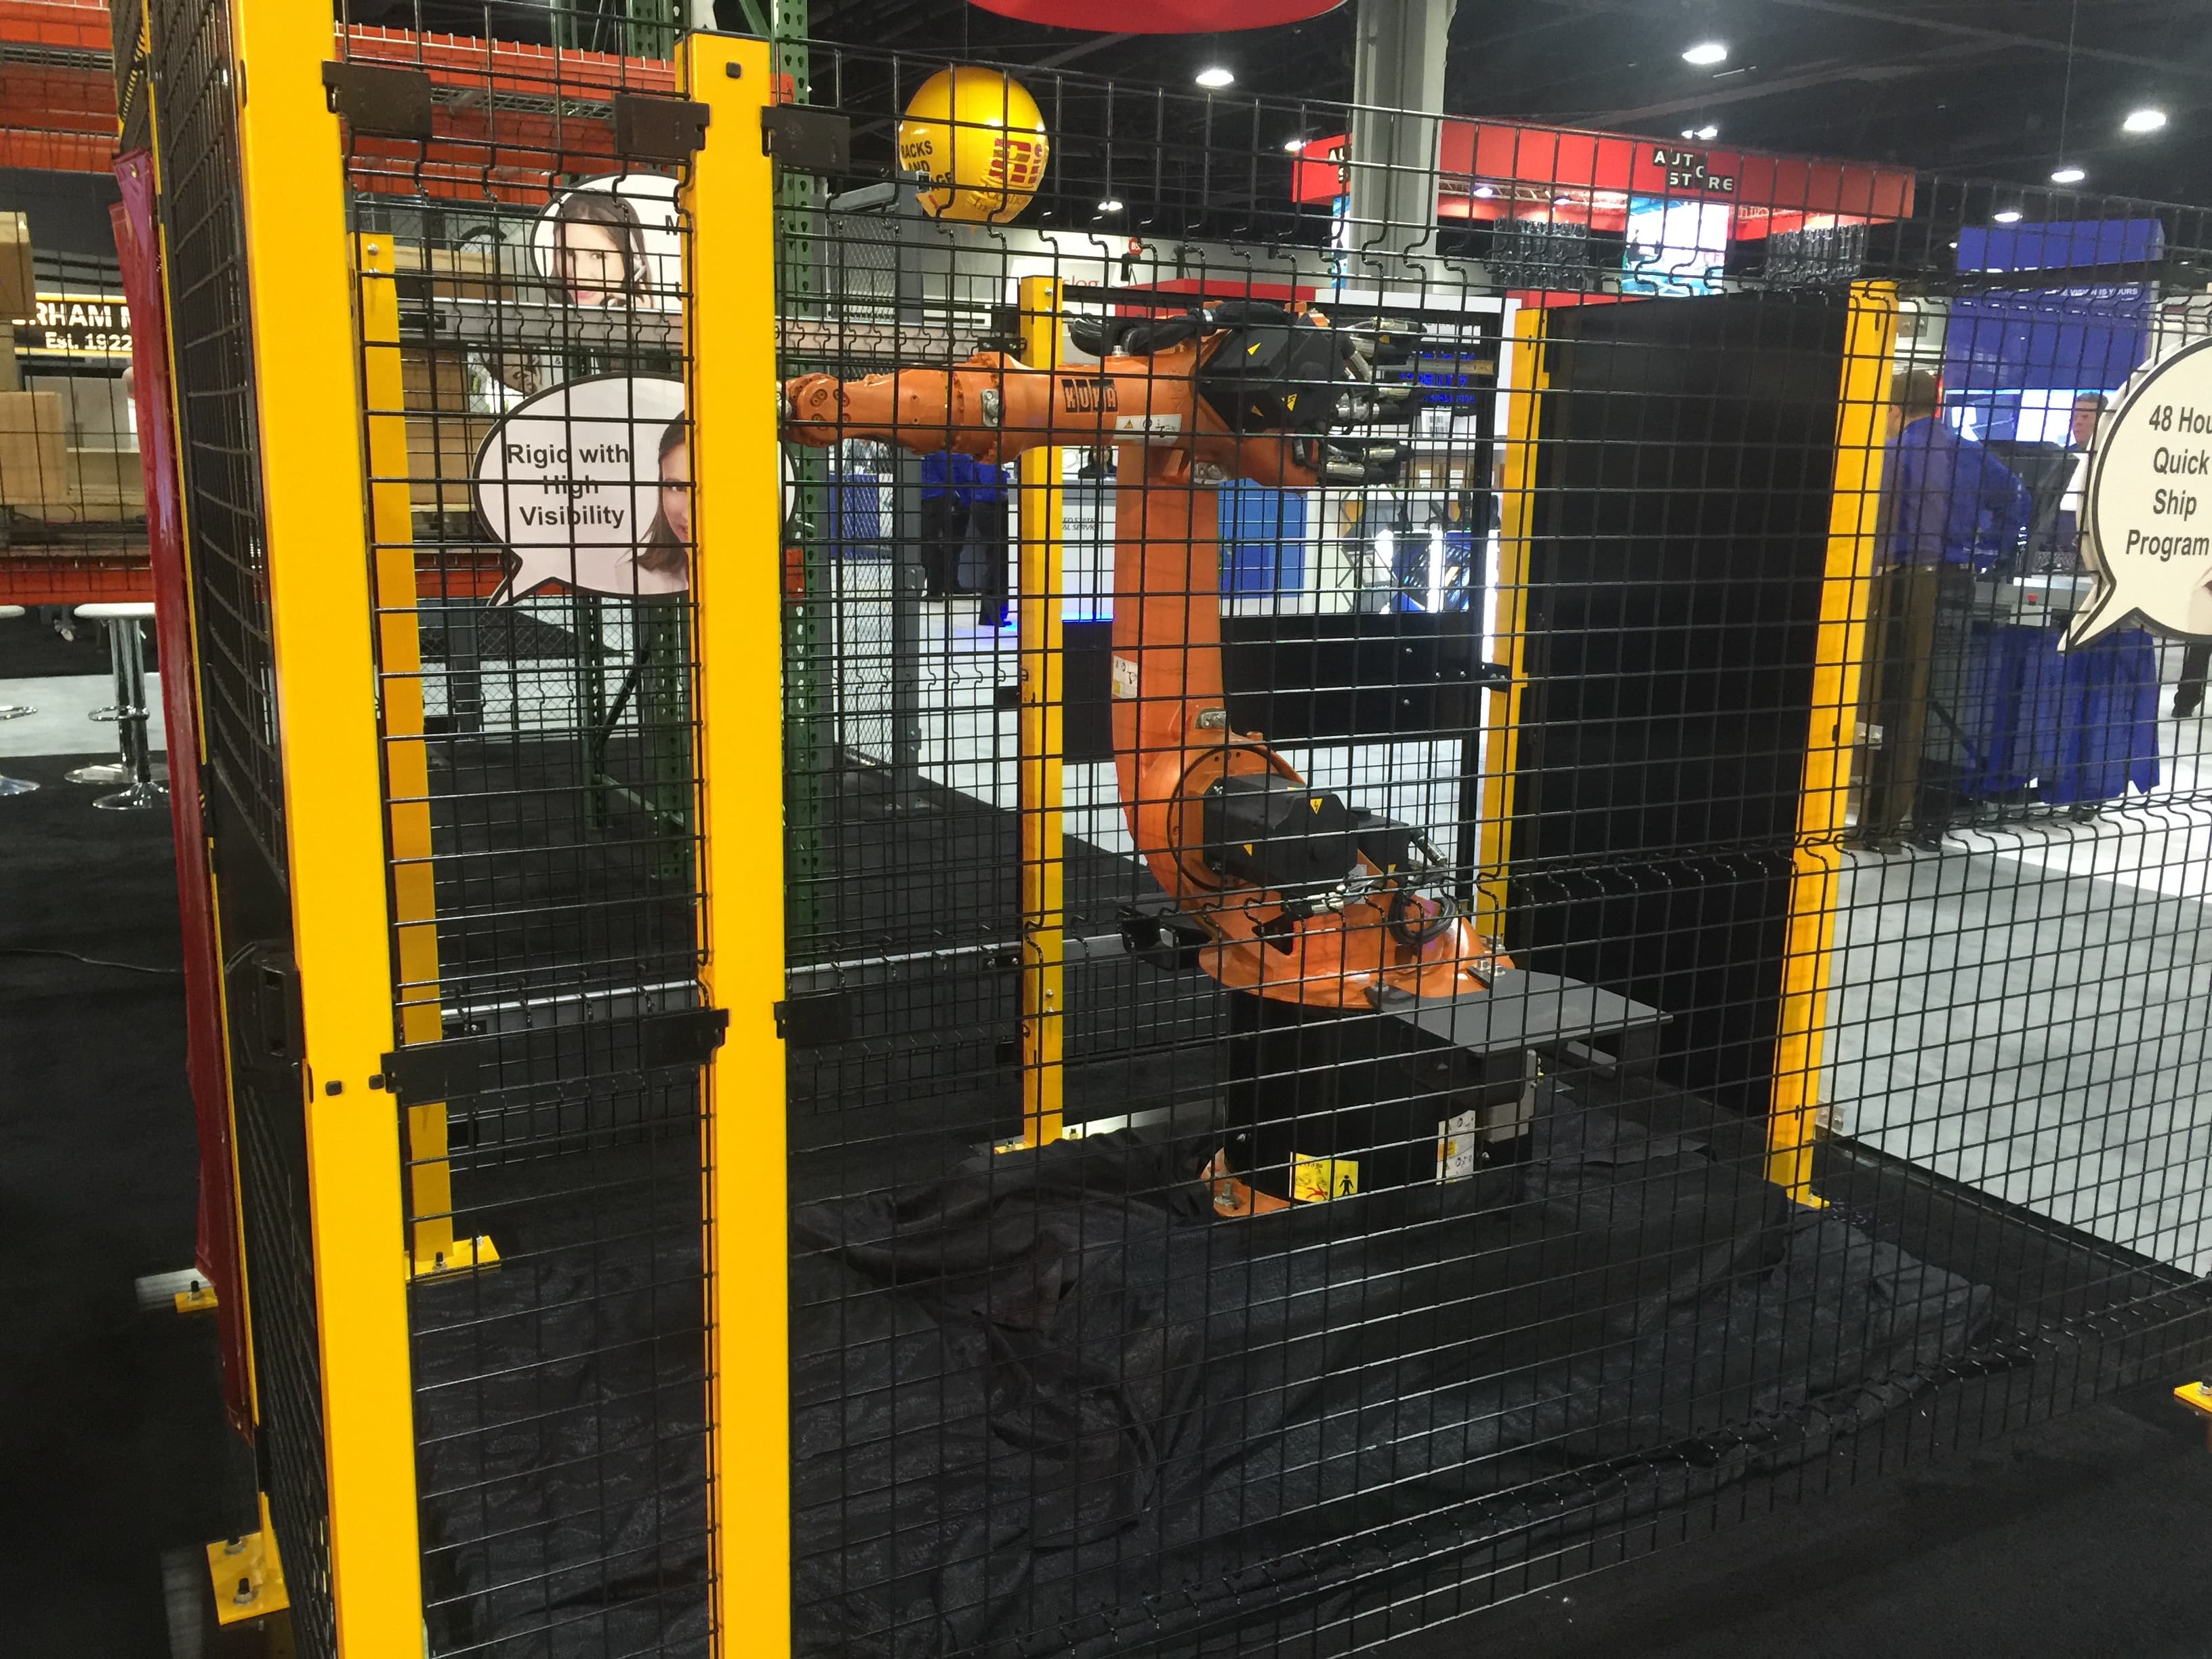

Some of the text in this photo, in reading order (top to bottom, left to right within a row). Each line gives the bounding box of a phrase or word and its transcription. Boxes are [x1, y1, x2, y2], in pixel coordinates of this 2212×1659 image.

[901, 140, 933, 159] RACKS
[85, 333, 133, 352] 1922
[2149, 405, 2173, 432] 48
[579, 444, 630, 464] with
[2153, 447, 2210, 475] Quick
[543, 474, 598, 499] High
[519, 505, 625, 529] Visibility
[2152, 488, 2197, 522] Ship
[2125, 529, 2210, 562] Program
